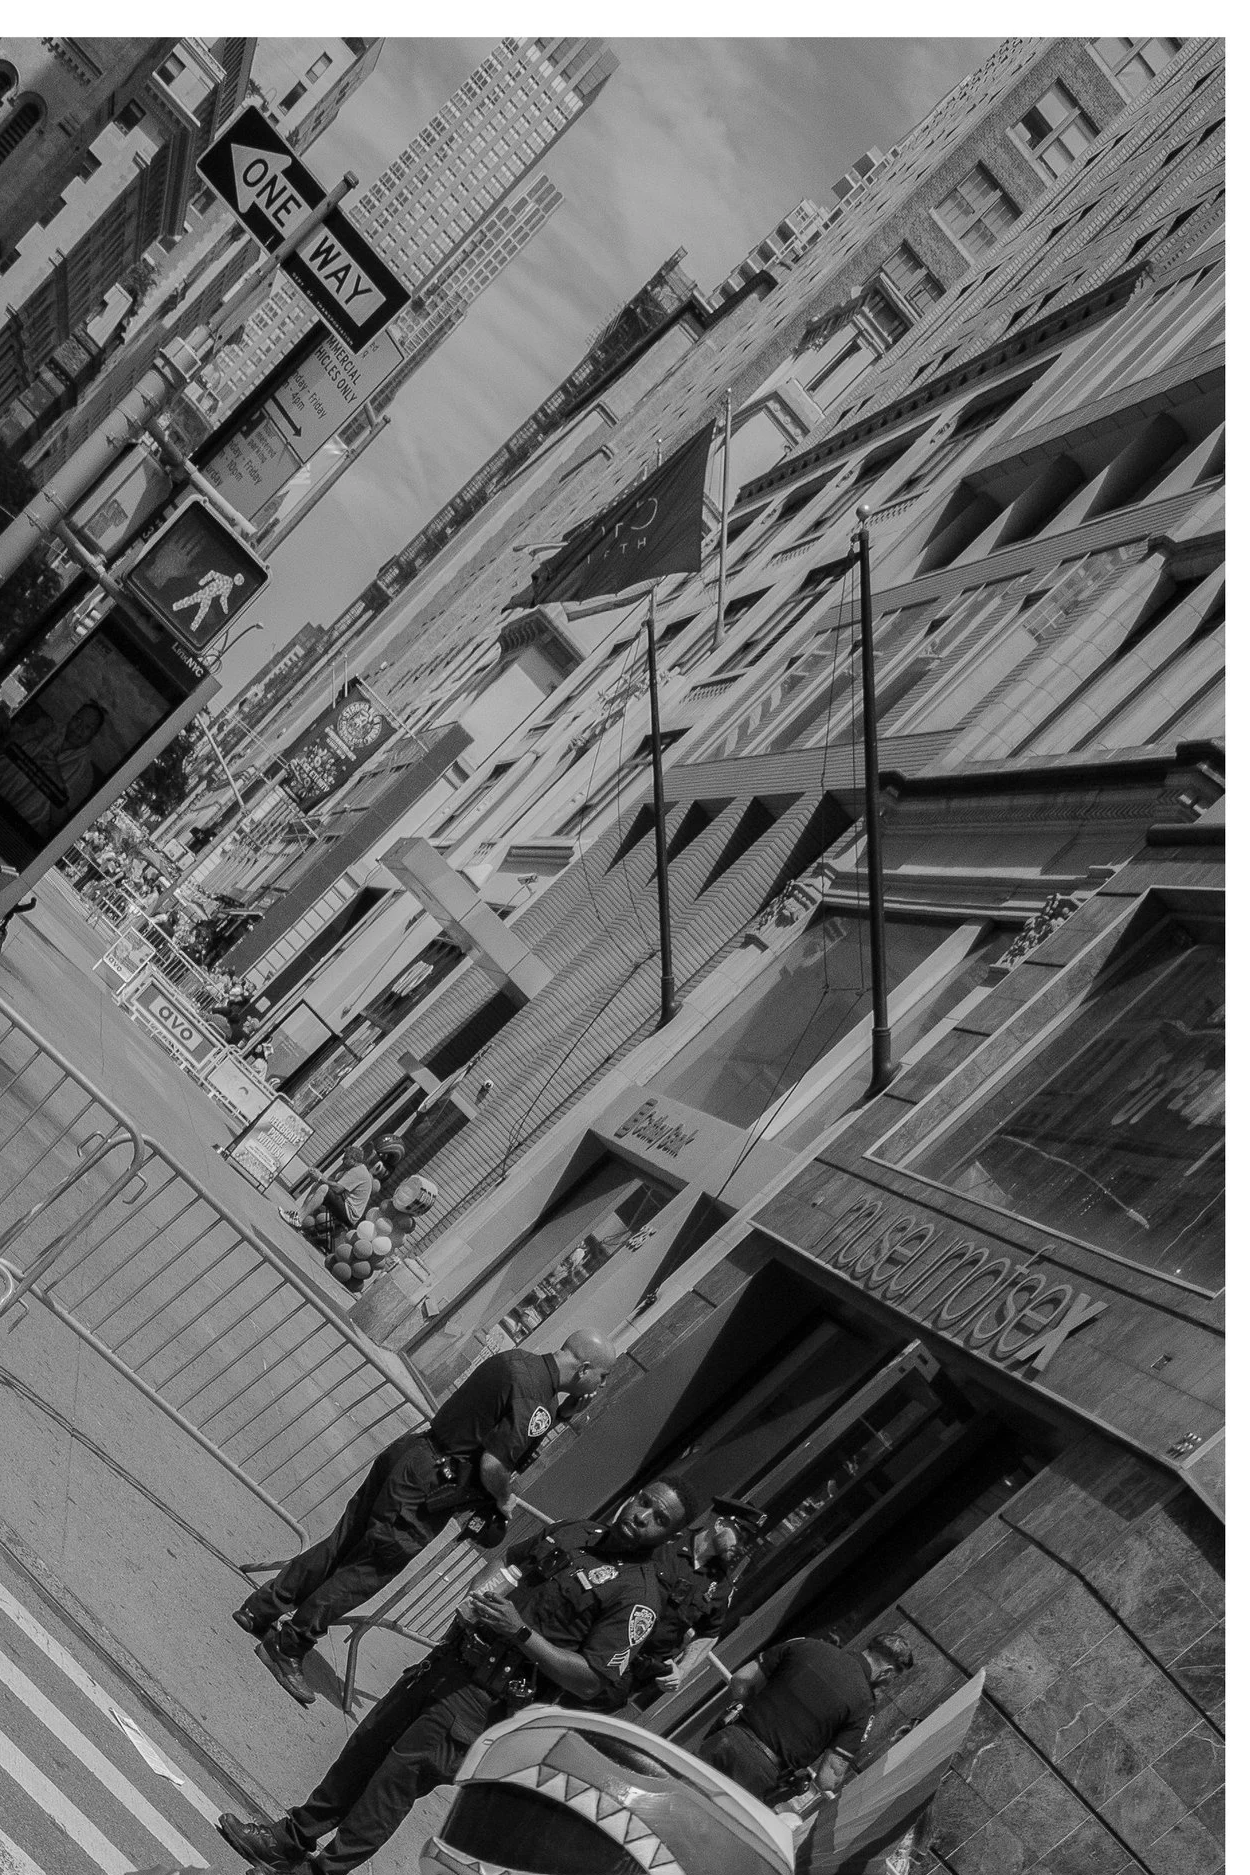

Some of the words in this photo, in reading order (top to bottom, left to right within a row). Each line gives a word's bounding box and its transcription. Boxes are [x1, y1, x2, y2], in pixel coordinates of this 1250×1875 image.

[243, 158, 302, 229] ONE
[308, 235, 373, 305] WAY
[316, 301, 354, 347] TRANSPORTATION
[313, 345, 342, 382] HICLES
[334, 377, 357, 404] ONLY
[325, 334, 363, 386] MMERCIAL
[290, 390, 306, 411] 4pm
[291, 370, 309, 392] nday
[307, 392, 328, 419] Friday
[204, 463, 224, 488] urday
[226, 439, 243, 458] nday
[242, 459, 263, 485] Friday
[170, 641, 205, 678] LinkNYC
[107, 955, 124, 973] avo
[156, 1003, 195, 1043] avo
[255, 1130, 275, 1151] WITH
[265, 1126, 288, 1148] PRIDE
